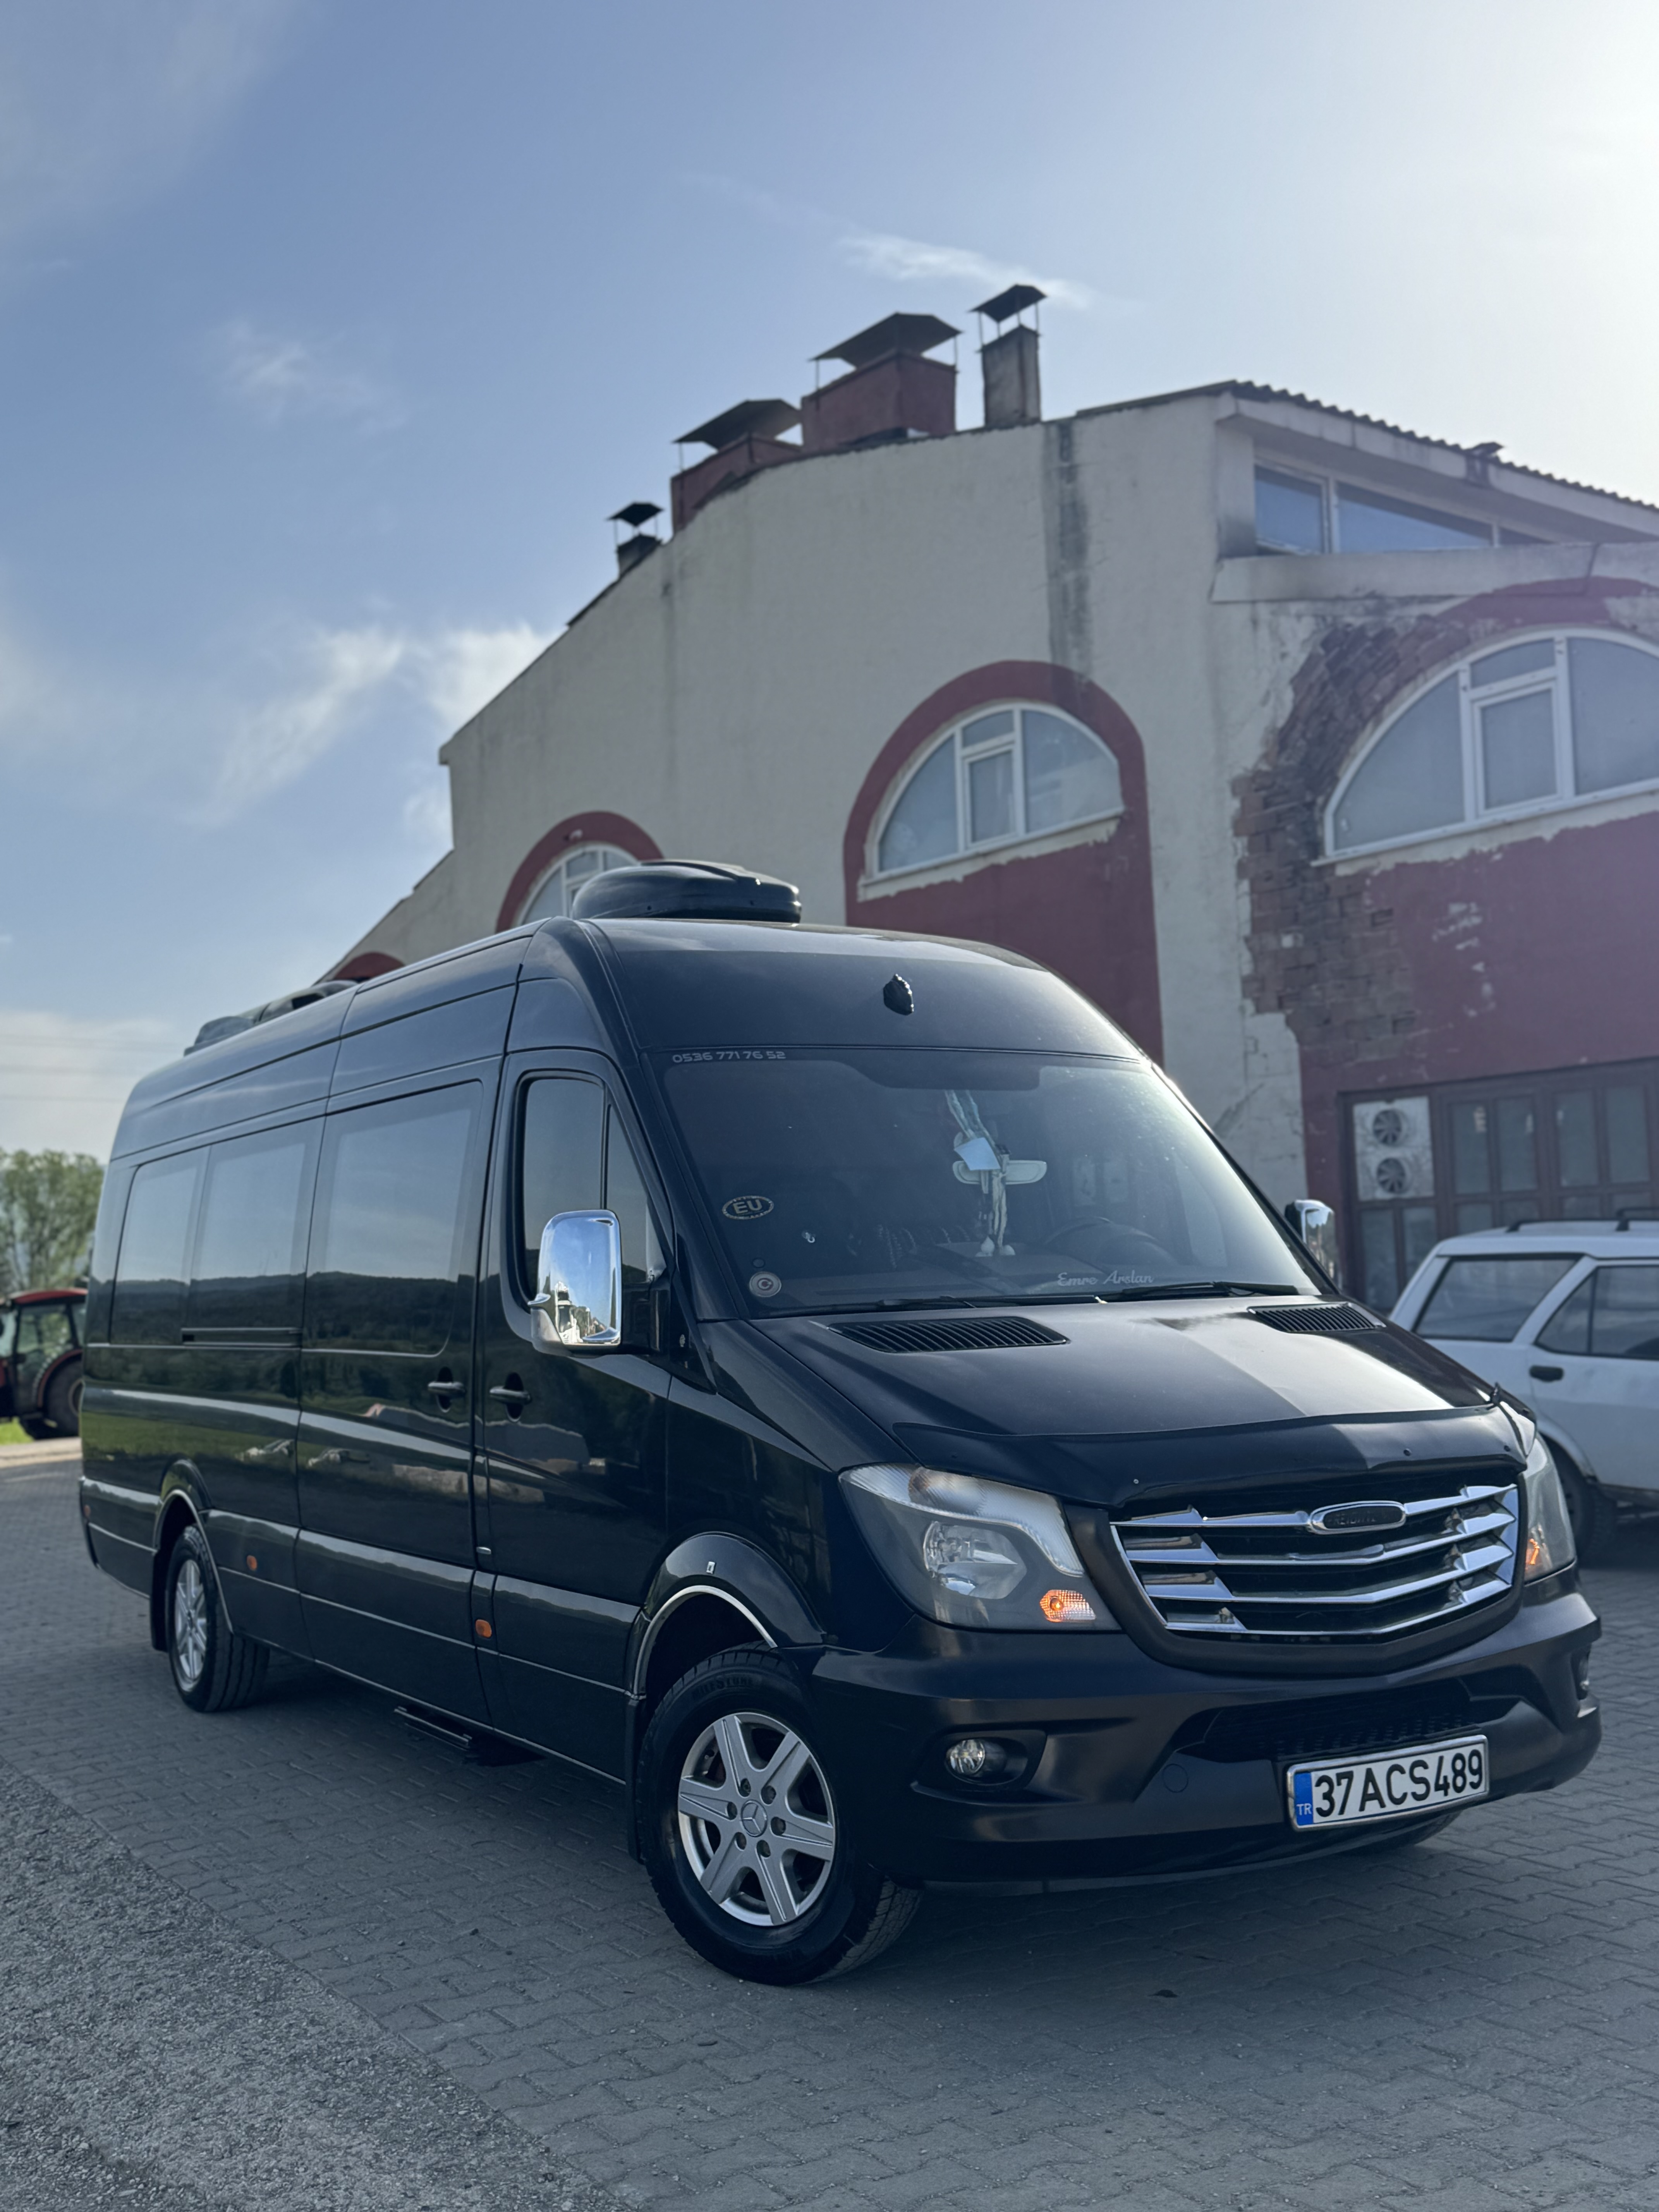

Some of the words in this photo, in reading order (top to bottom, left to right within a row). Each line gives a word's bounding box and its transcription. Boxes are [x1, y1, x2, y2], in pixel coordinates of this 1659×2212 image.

[672, 1052, 713, 1063] 0536
[716, 1051, 740, 1060] 771
[742, 1051, 763, 1060] 76
[766, 1051, 786, 1060] 52
[733, 1199, 763, 1214] EU
[1057, 1272, 1098, 1286] Emre
[1103, 1269, 1154, 1284] Arslan
[1297, 1803, 1312, 1816] TR
